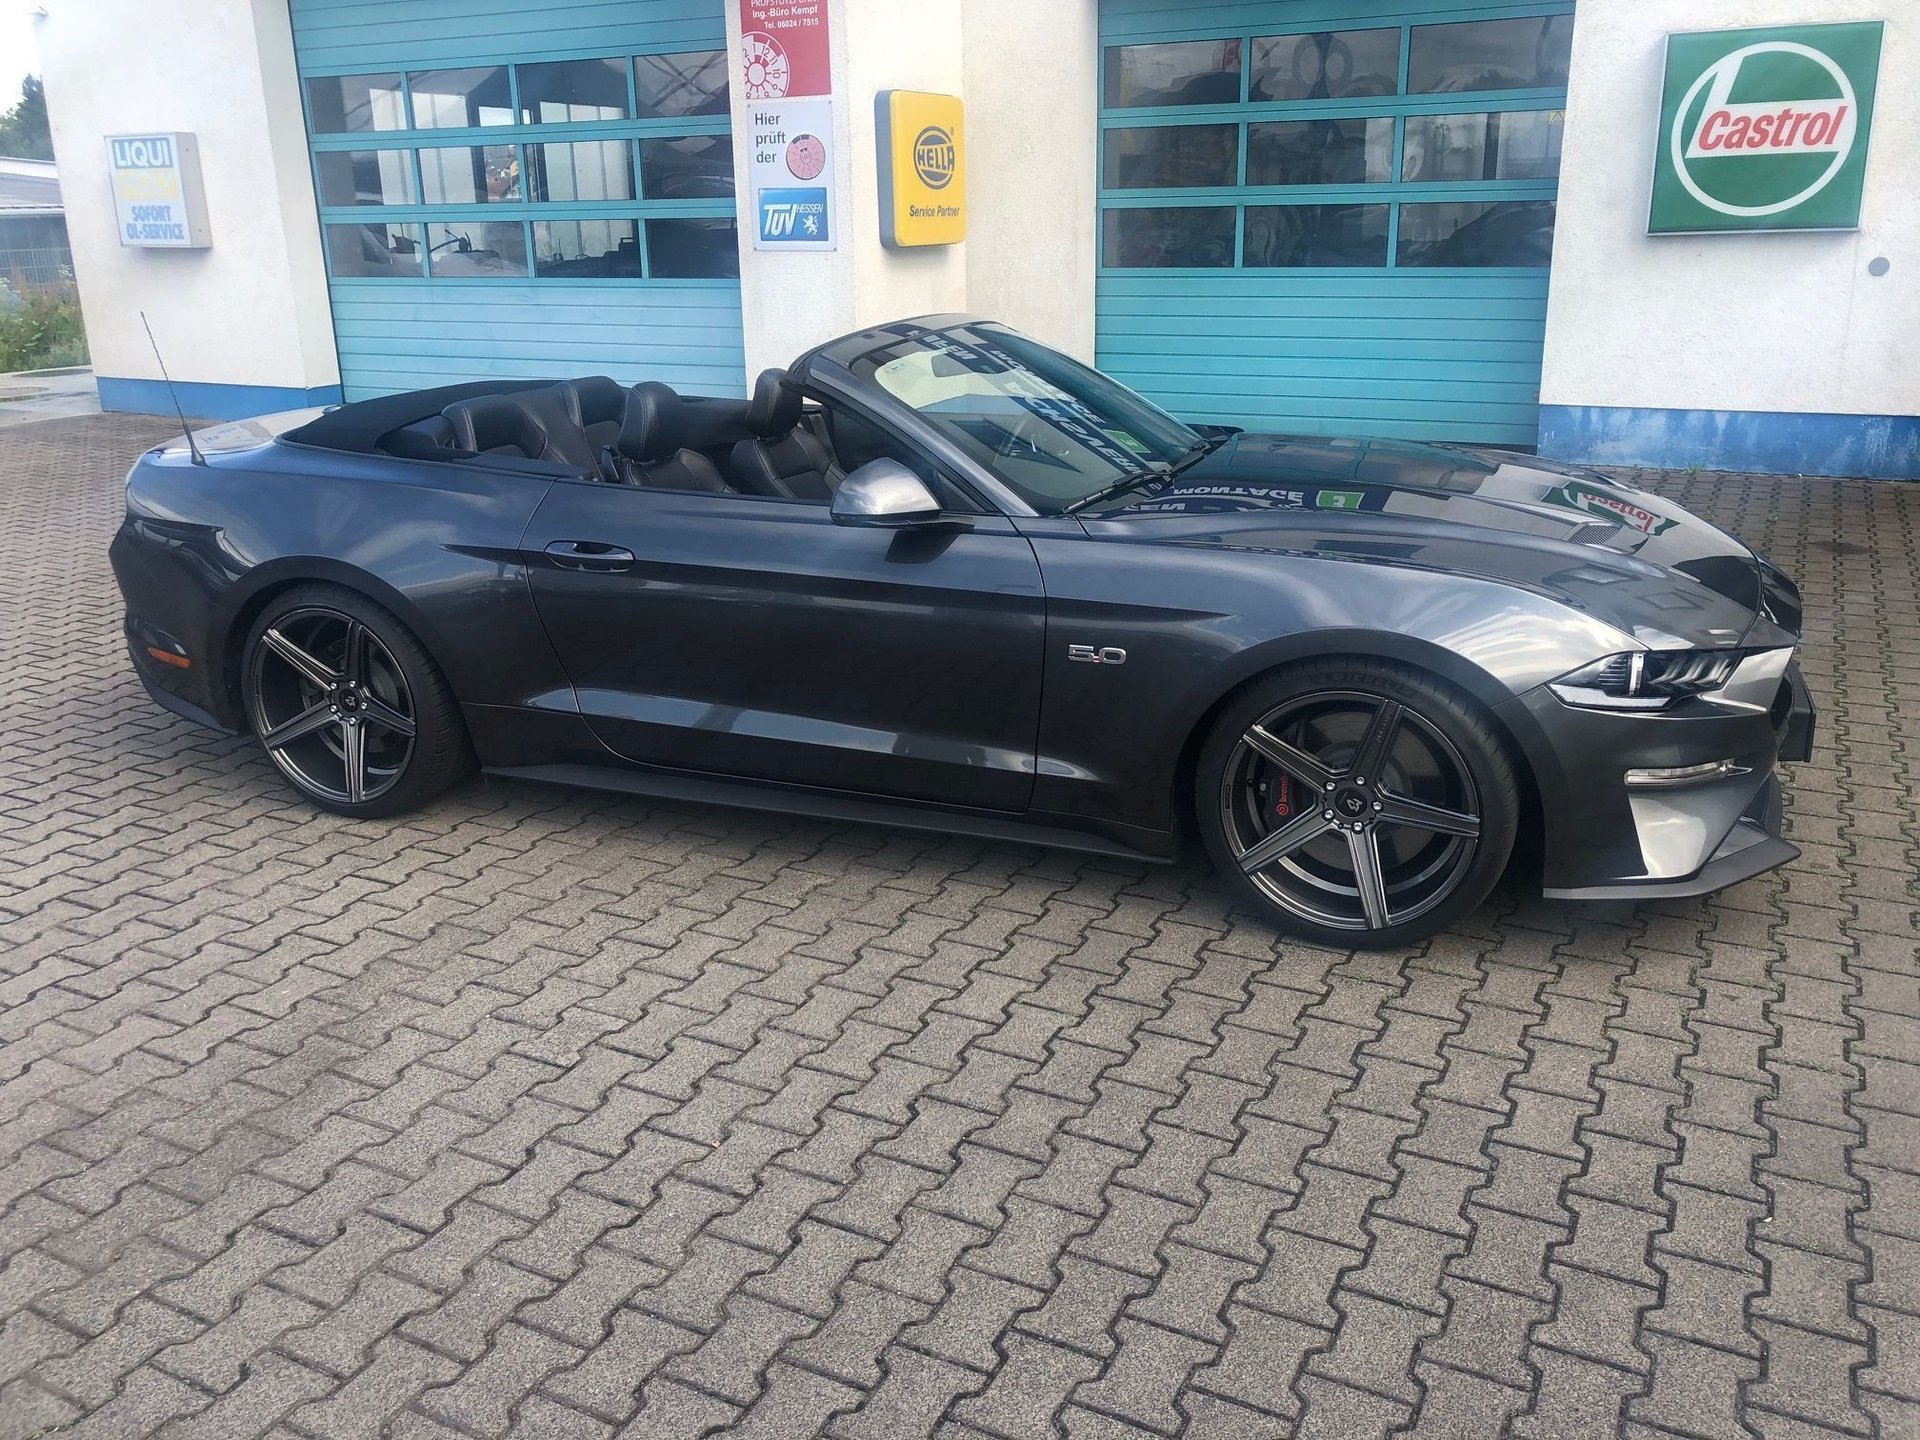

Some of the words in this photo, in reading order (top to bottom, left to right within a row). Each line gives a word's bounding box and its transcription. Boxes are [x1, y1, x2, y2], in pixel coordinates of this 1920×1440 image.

[752, 7, 790, 20] Ing.-Büro
[791, 5, 818, 16] Kempf
[764, 21, 776, 29] Tel.
[777, 19, 797, 28] 06024
[802, 18, 819, 26] 7515
[755, 112, 781, 126] Hier
[1699, 105, 1848, 151] Castrol
[755, 131, 786, 148] prüft
[113, 140, 171, 168] LIQUI
[756, 150, 777, 163] der
[916, 145, 955, 172] HELLA
[131, 205, 172, 222] SOFORT
[796, 203, 824, 214] HESSEN
[909, 204, 936, 218] Service
[936, 204, 961, 217] Partner
[1067, 644, 1127, 665] 5.0
